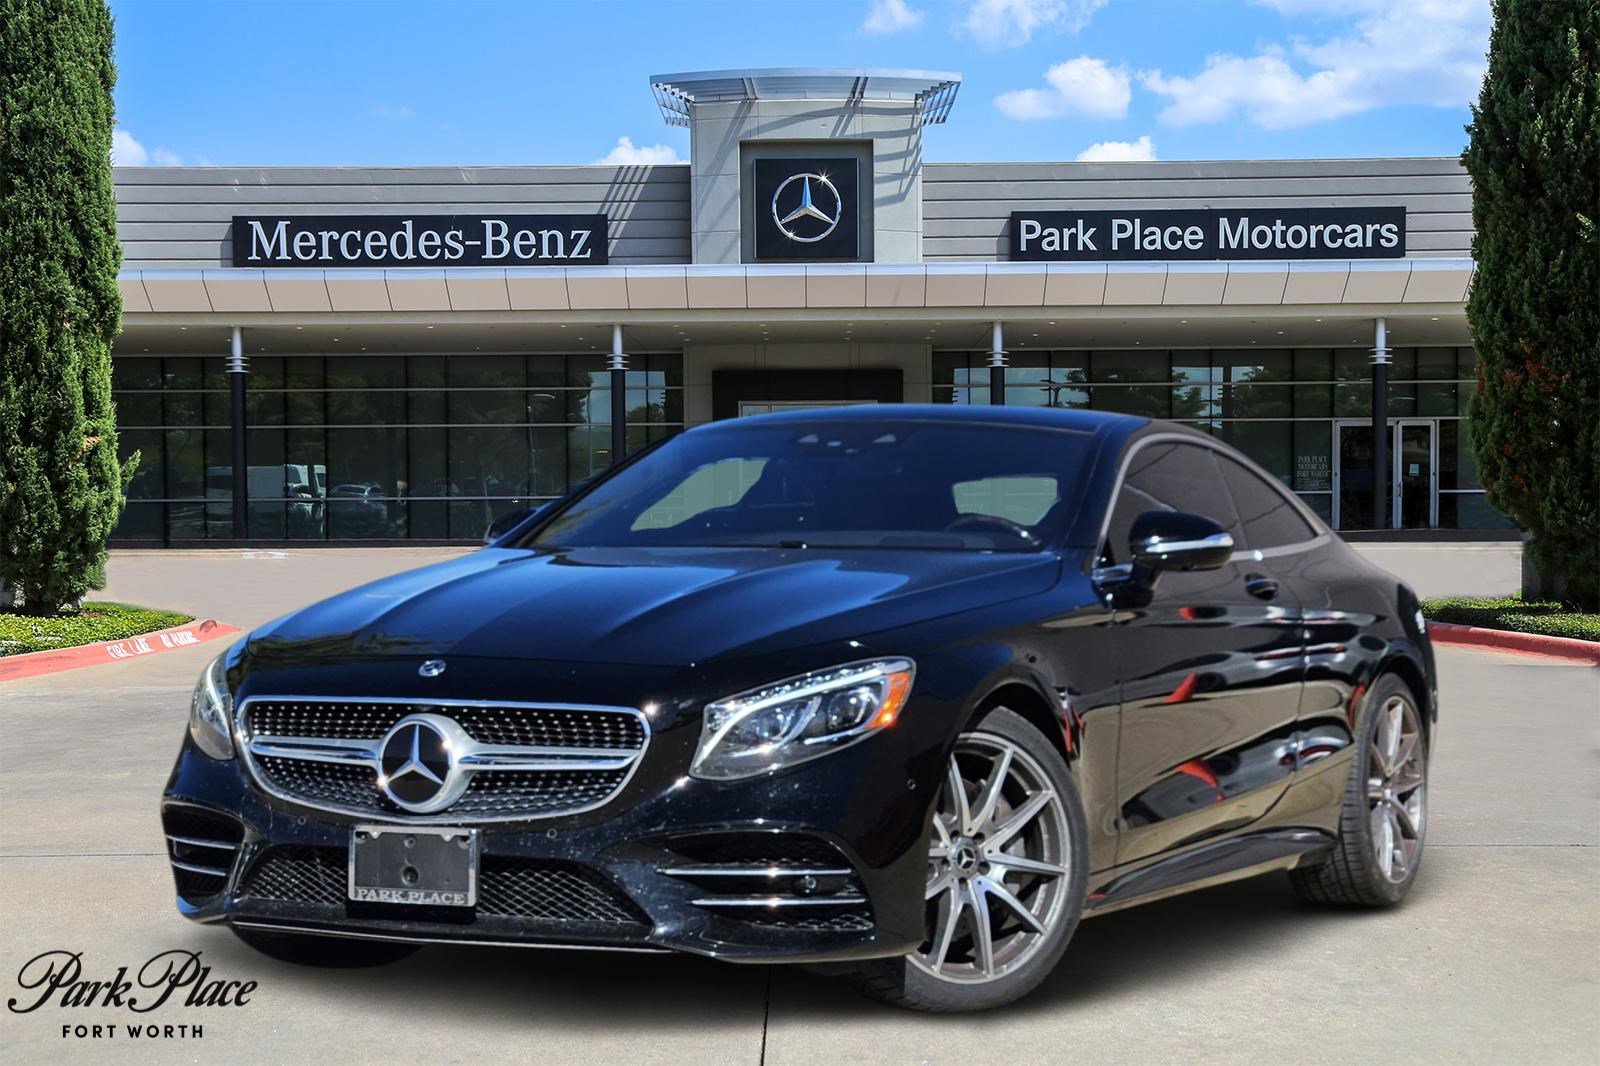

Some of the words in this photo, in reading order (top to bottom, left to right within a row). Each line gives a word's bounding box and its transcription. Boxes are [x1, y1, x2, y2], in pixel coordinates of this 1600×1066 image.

[247, 219, 592, 261] Mercedes-Benz
[1019, 218, 1098, 252] Park
[1111, 218, 1204, 251] Place
[1218, 217, 1399, 250] Motorcars
[105, 643, 134, 659] FIRE
[128, 636, 154, 655] LANE
[160, 631, 175, 648] NO
[357, 888, 403, 901] PARK
[407, 891, 466, 904] PLACE
